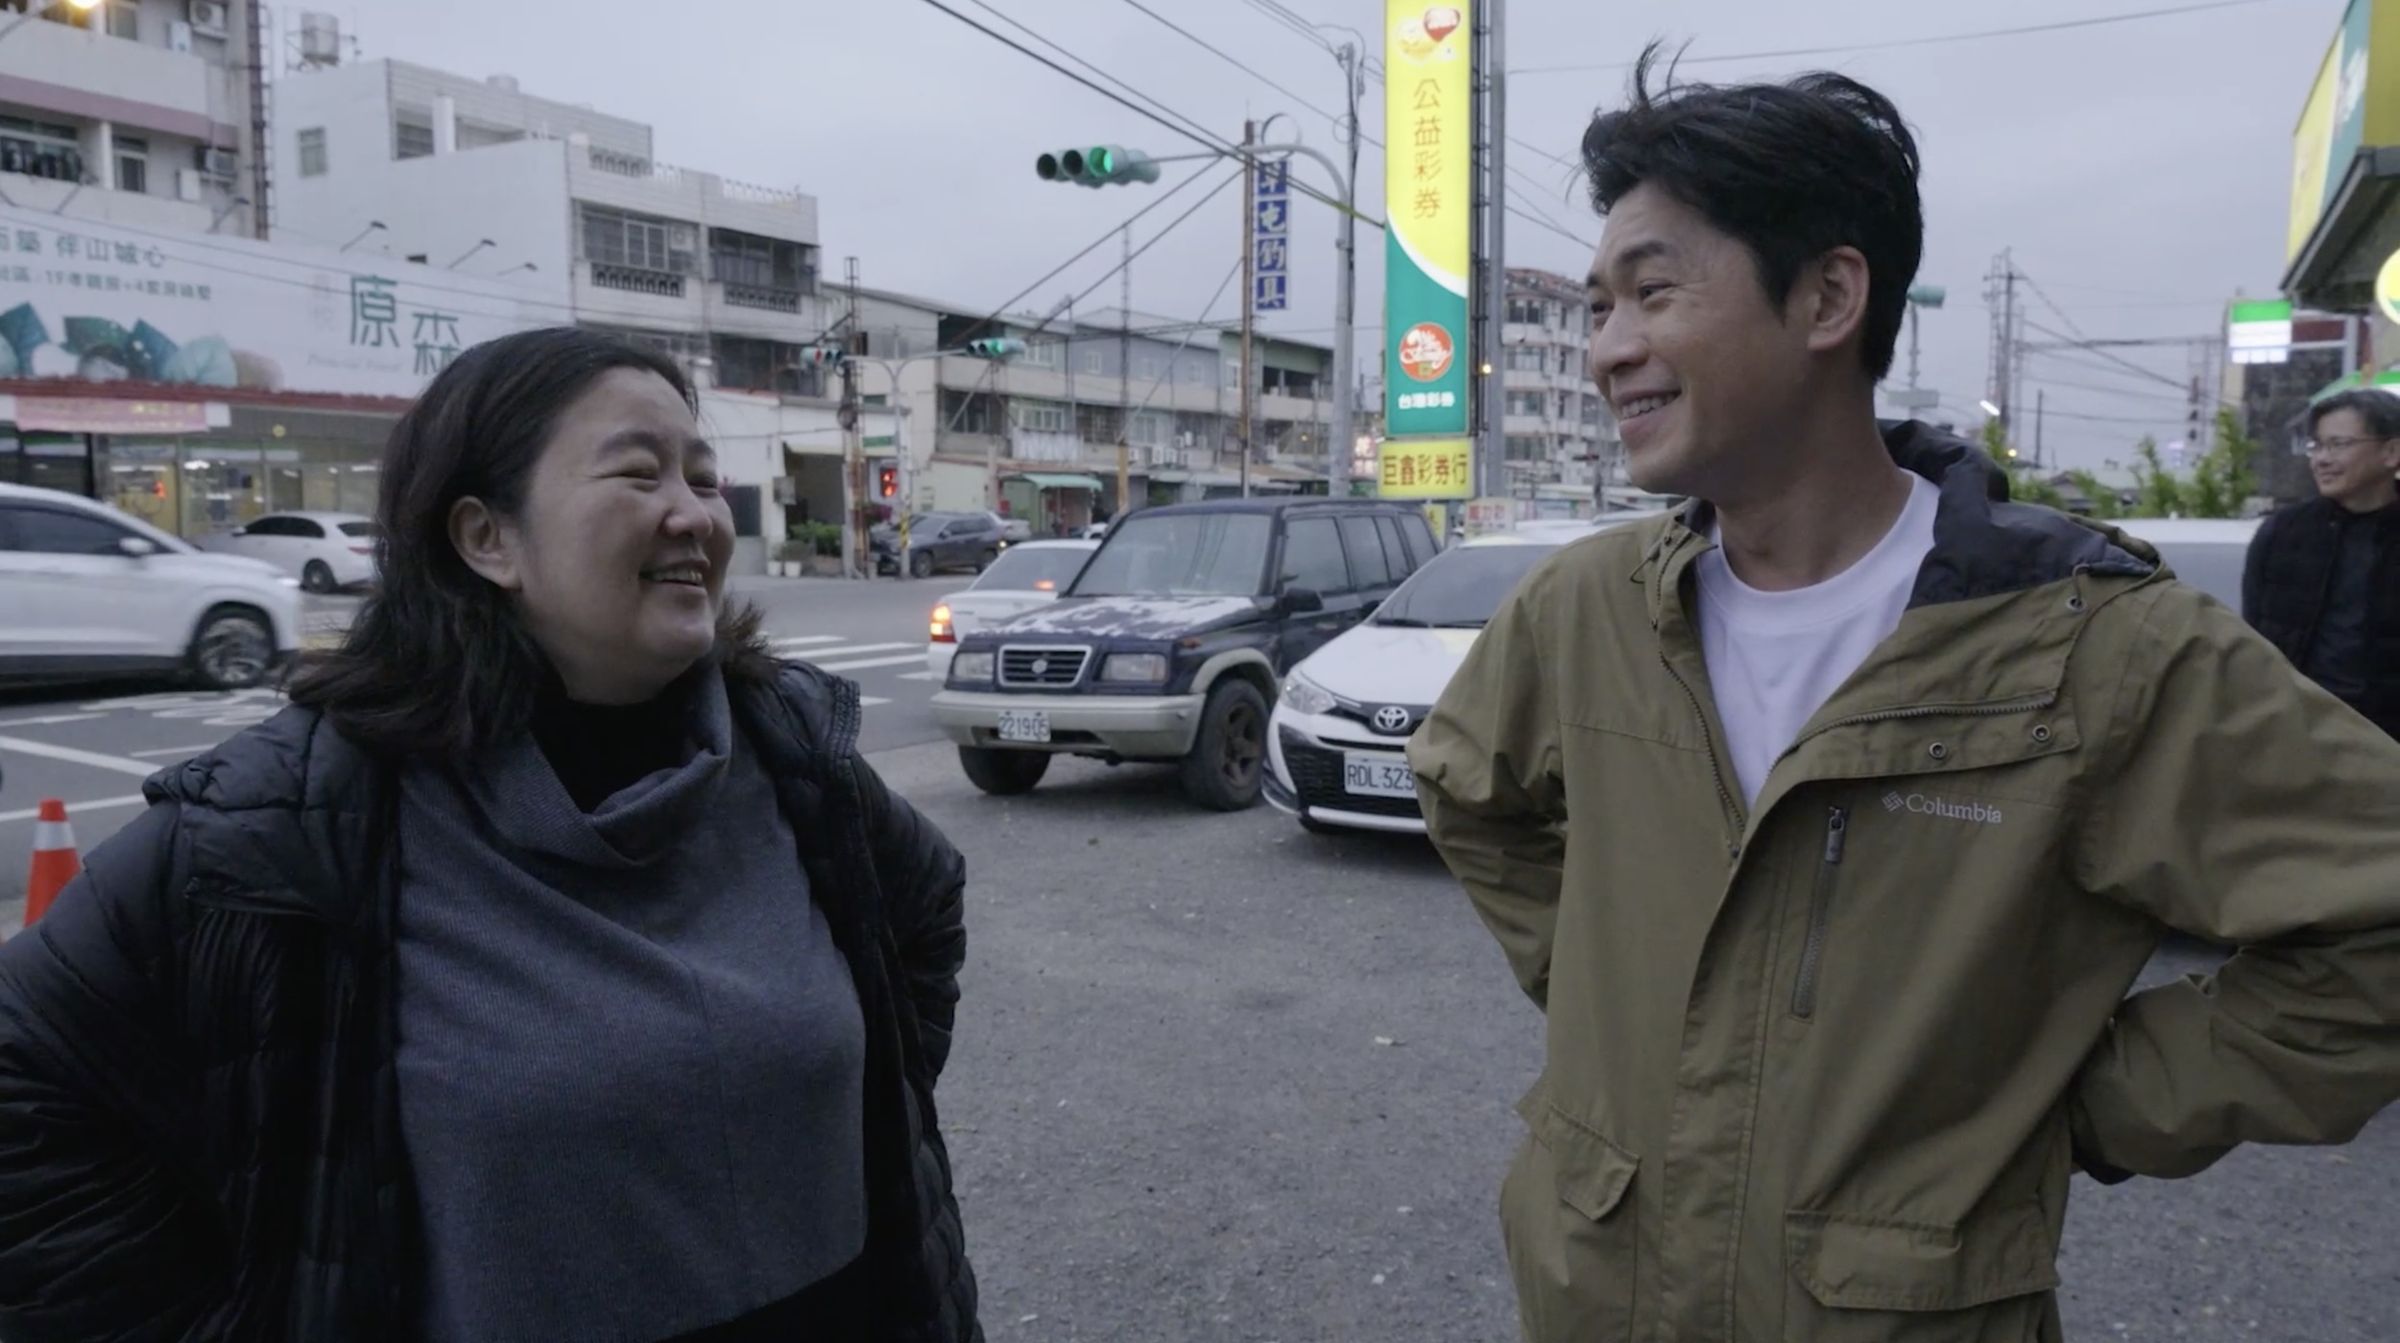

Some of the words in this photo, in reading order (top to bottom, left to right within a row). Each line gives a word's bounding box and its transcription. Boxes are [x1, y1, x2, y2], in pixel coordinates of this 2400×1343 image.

[1413, 76, 1443, 221] 公益彩券
[1382, 453, 1469, 487] 巨鑫彩券行
[1905, 792, 2004, 824] Columbia
